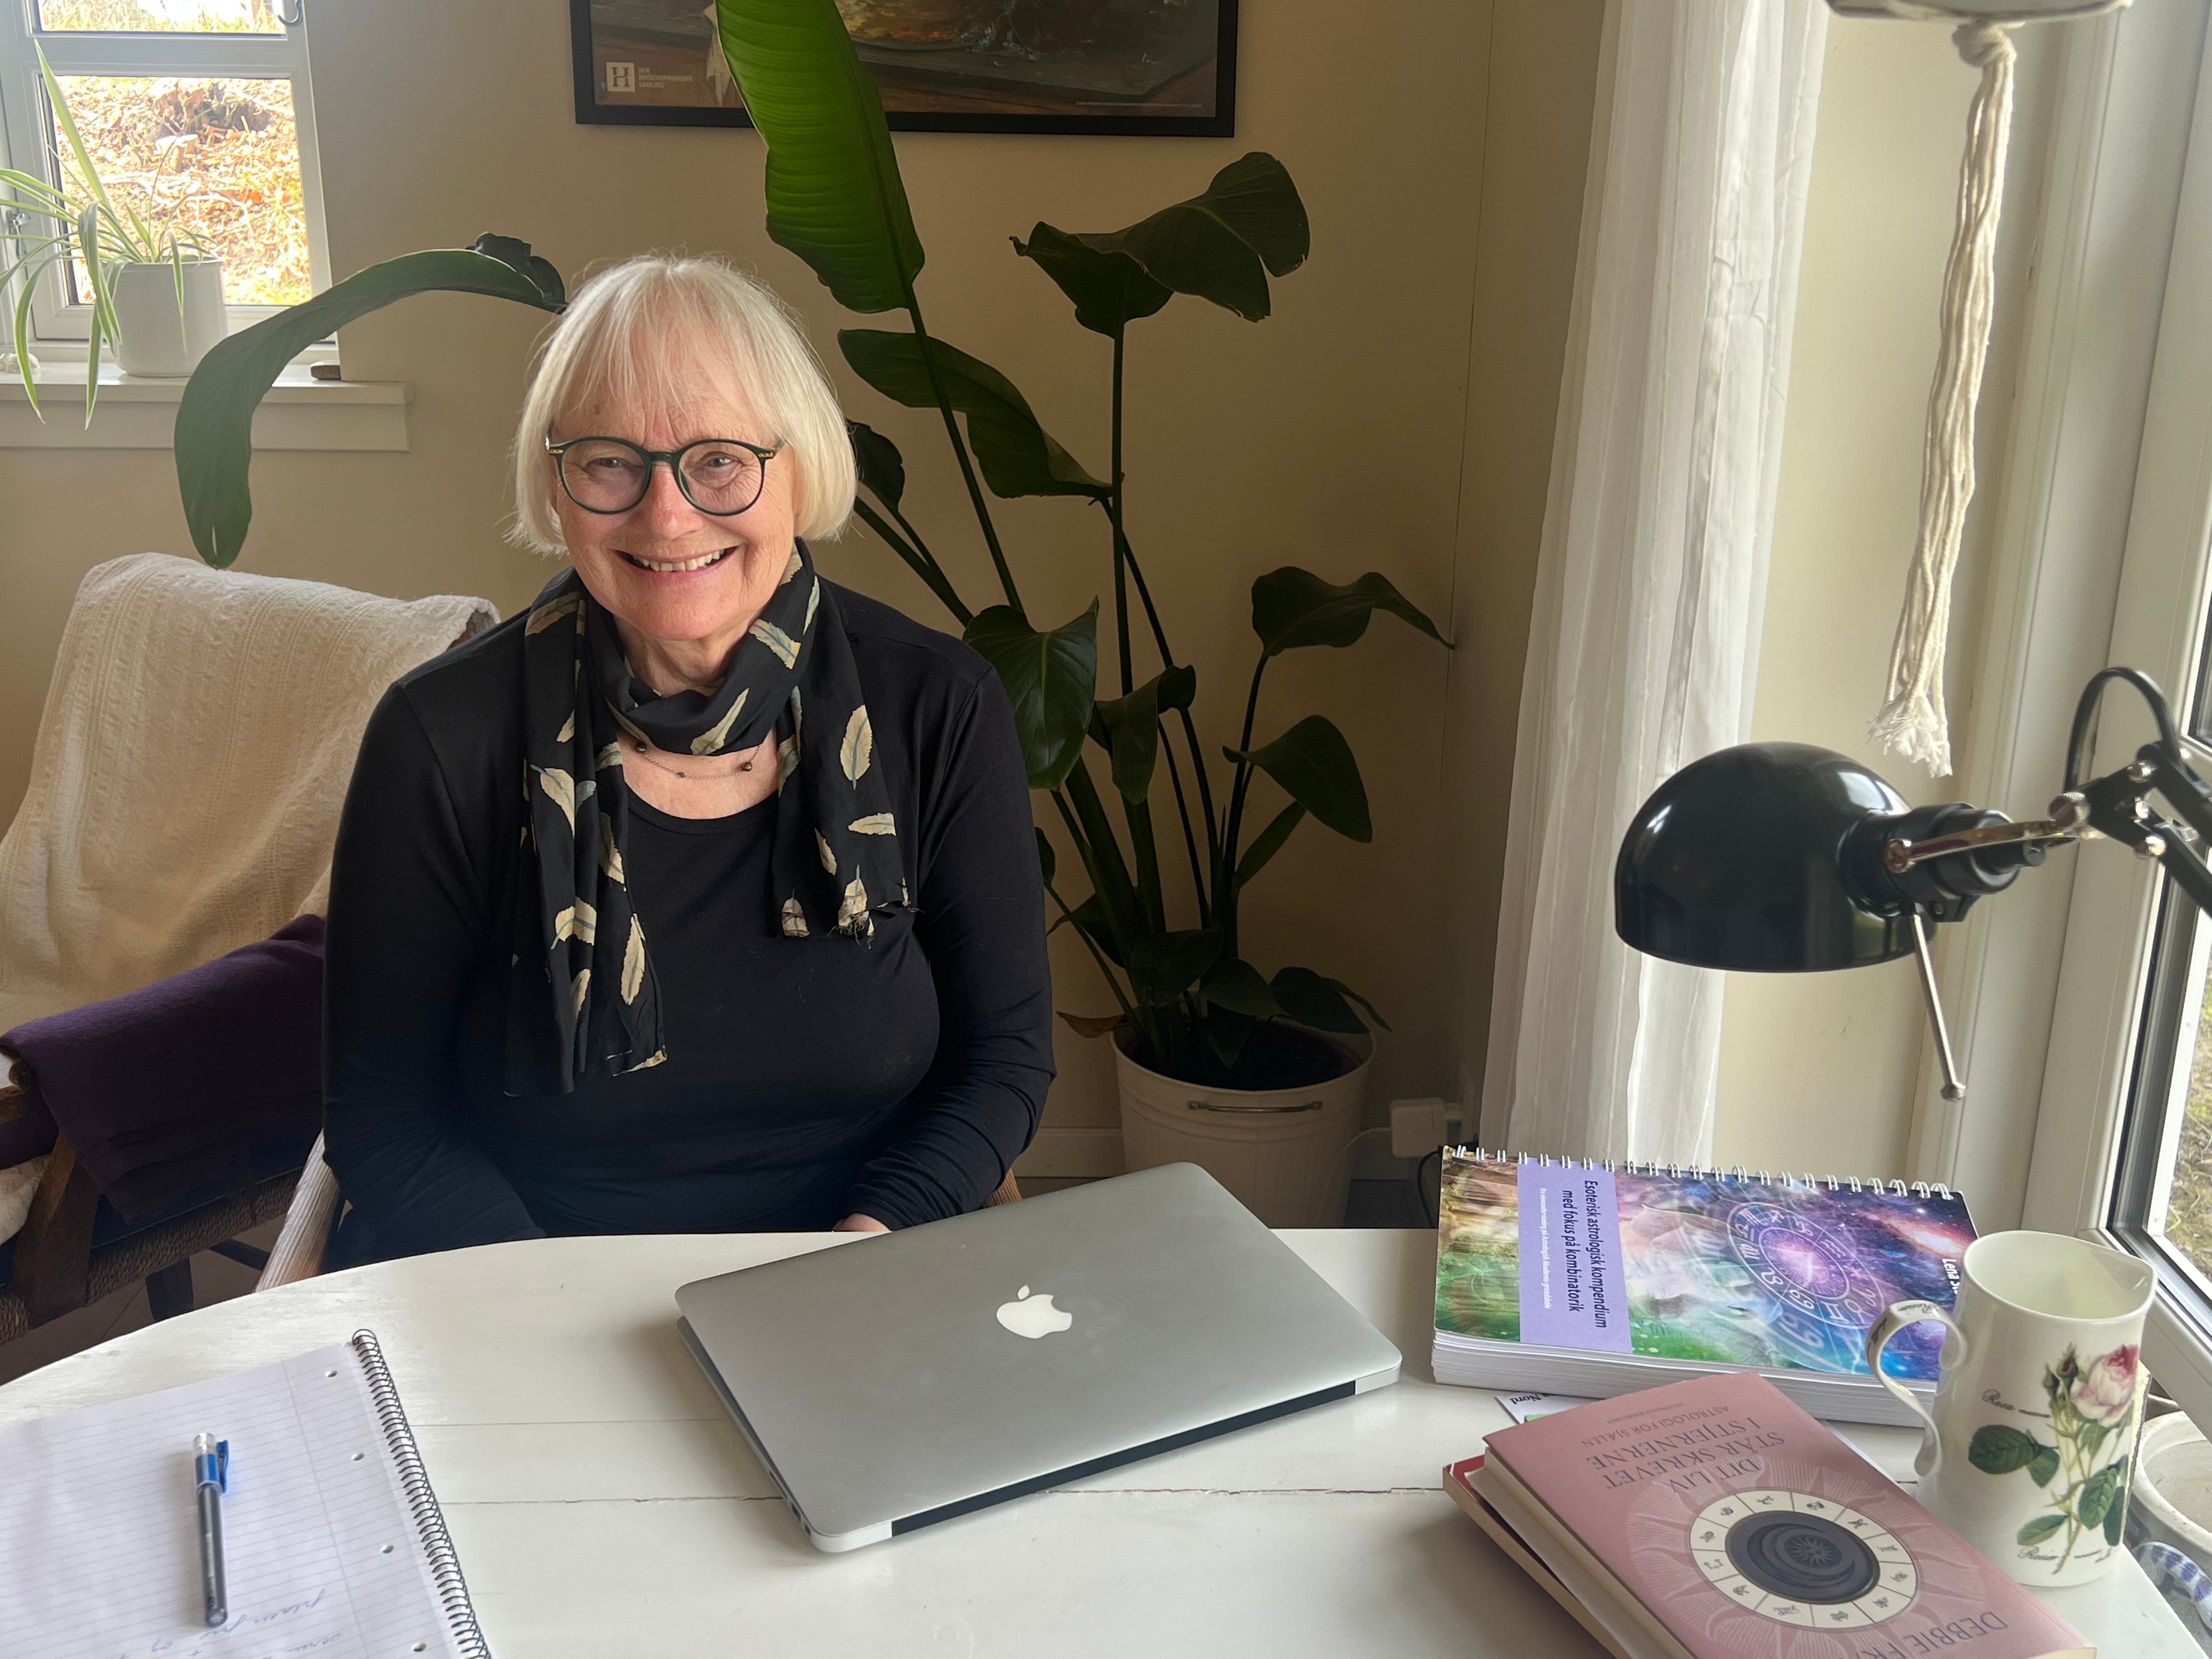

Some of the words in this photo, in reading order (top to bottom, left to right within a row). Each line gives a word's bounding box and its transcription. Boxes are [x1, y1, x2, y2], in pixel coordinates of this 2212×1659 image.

[1562, 1189, 1578, 1209] med
[1584, 1180, 1601, 1217] Esoterisk
[1562, 1210, 1578, 1234] fokus
[1561, 1235, 1581, 1247] på
[1585, 1218, 1606, 1265] astrologisk
[1942, 1258, 1960, 1279] Lena
[1565, 1248, 1585, 1313] kombinatorik
[1588, 1266, 1610, 1328] kompendium
[1510, 1394, 1542, 1404] Nord
[1659, 1405, 1729, 1427] ASTROLOGI
[1746, 1417, 1762, 1429] I
[1581, 1426, 1628, 1448] SJÆLEN
[1629, 1421, 1657, 1435] FOR
[1585, 1419, 1746, 1470] STJERNERNE
[1714, 1431, 1785, 1456] STÅR
[1600, 1449, 1716, 1489] SKREVET
[1713, 1458, 1760, 1480] DIT
[1667, 1471, 1712, 1493] LIV
[1901, 1611, 2008, 1655] DEBBIE
[1855, 1641, 1906, 1659] FR
